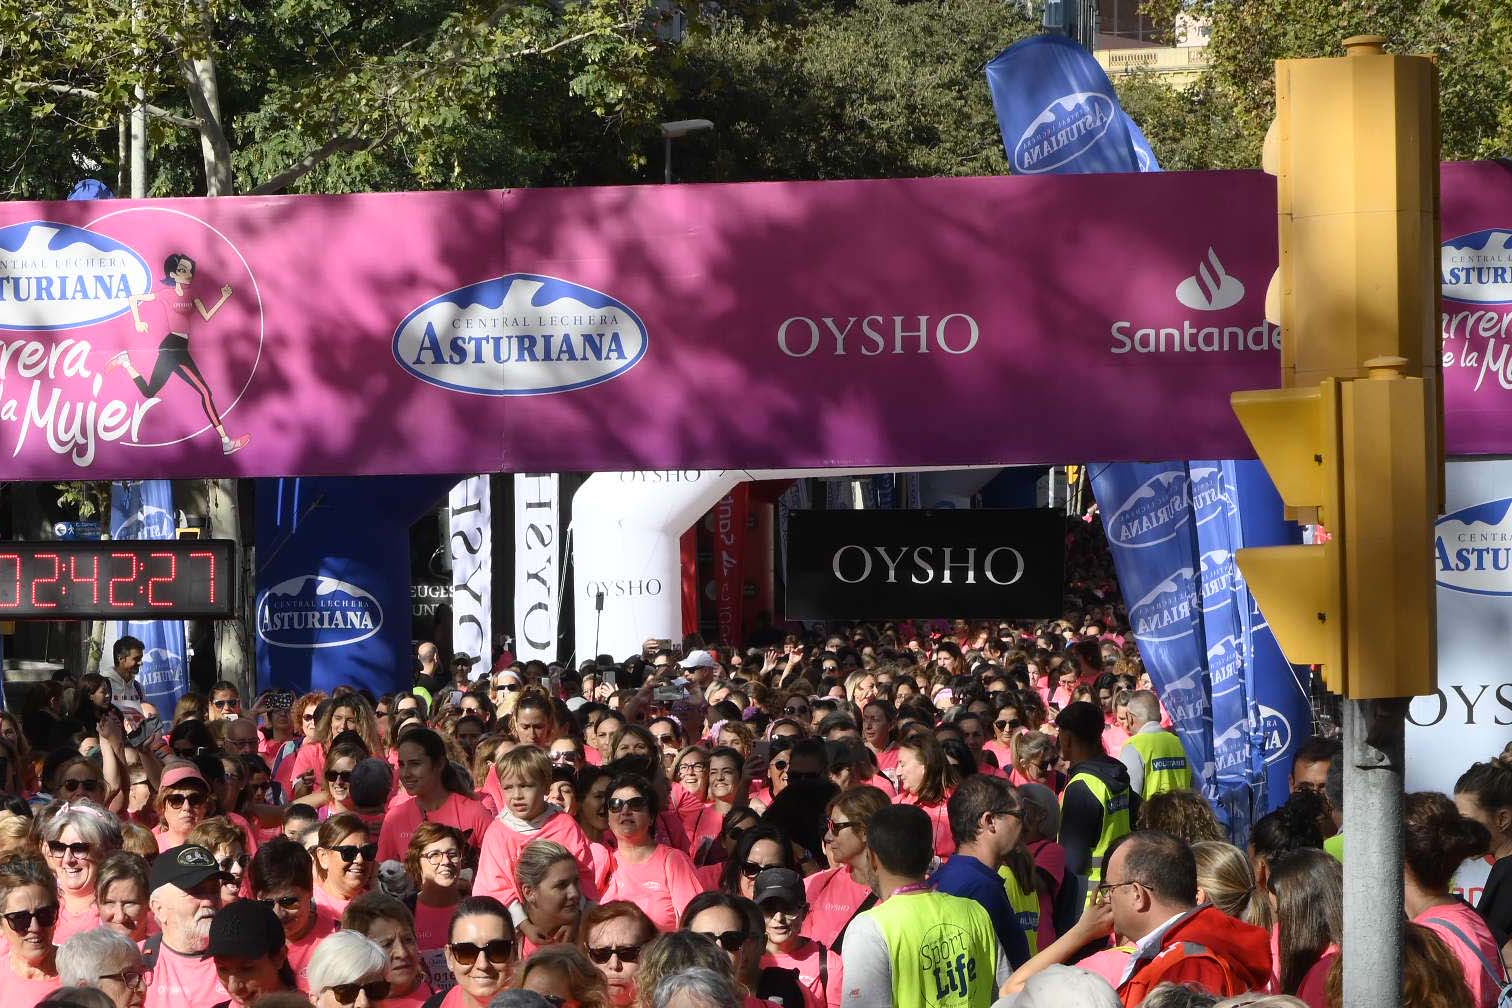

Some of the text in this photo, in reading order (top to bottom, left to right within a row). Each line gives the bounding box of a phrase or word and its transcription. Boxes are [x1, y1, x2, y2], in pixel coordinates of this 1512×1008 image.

[55, 258, 127, 268] LECHERA
[452, 314, 620, 329] CENTRAL LECHERA
[778, 312, 980, 358] OYSHO
[413, 321, 628, 366] ASTURIANA
[1460, 340, 1479, 368] la
[13, 371, 162, 468] Mujer
[831, 544, 1026, 587] OYSHO
[320, 600, 369, 608] LECHERA
[586, 578, 662, 599] OYSHO
[262, 604, 374, 633] ASTURIANA
[921, 929, 968, 971] Sport
[934, 953, 977, 1000] Life
